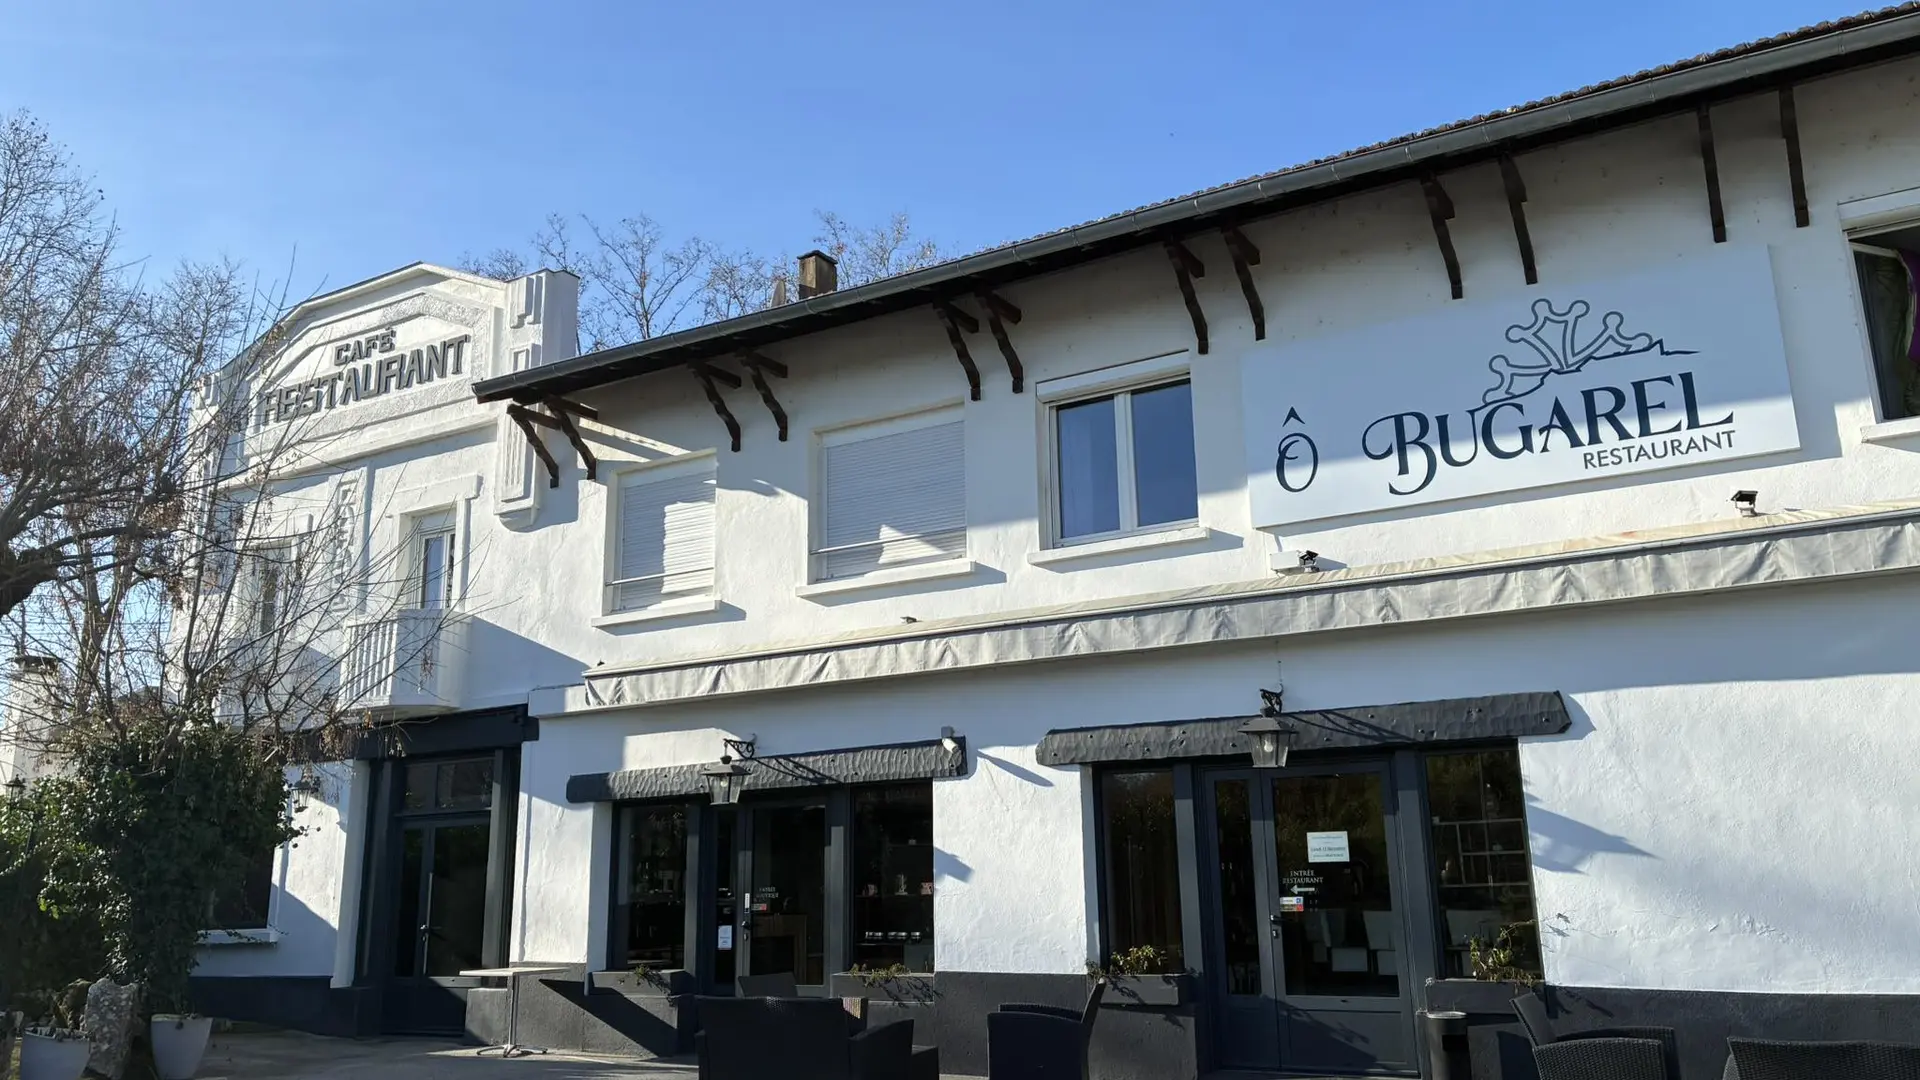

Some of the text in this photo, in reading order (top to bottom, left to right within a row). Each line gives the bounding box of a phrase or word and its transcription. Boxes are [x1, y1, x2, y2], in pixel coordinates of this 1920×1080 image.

[262, 333, 471, 427] RESTAURANT
[1275, 371, 1734, 496] Ô BUGAREL
[1583, 429, 1736, 470] RESTAURANT
